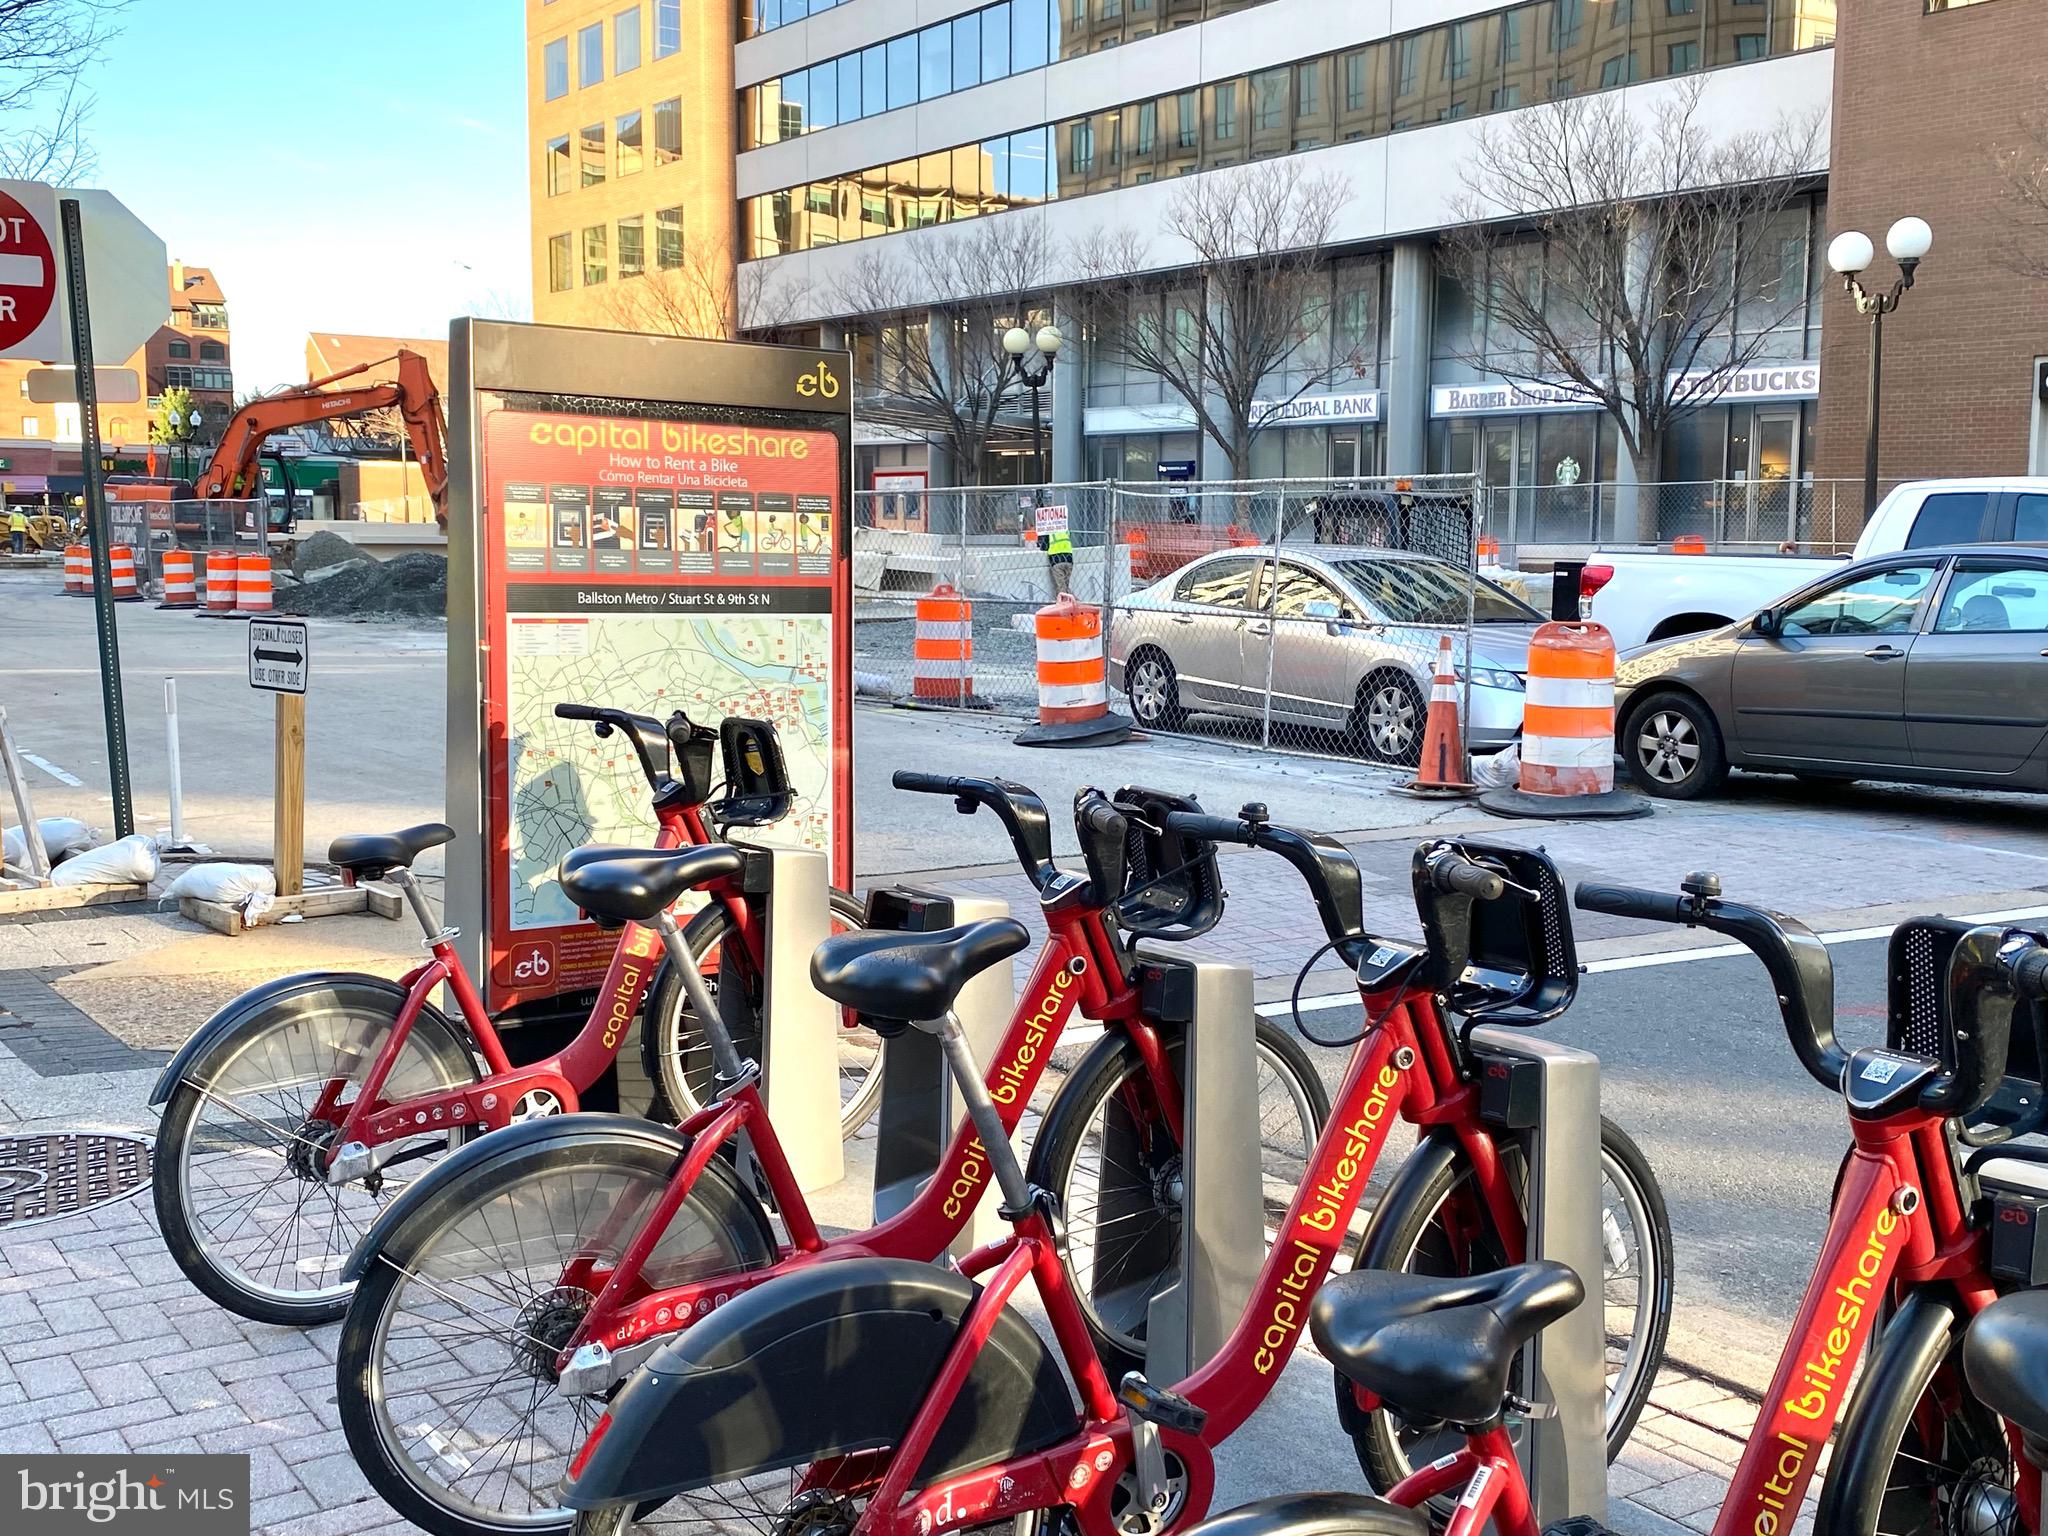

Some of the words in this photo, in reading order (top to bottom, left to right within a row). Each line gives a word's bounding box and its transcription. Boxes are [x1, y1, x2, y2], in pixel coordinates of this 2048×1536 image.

[1674, 370, 1816, 395] STARBUCKS
[321, 398, 351, 409] HITACHI
[1251, 400, 1331, 420] RESIDENTIAL
[1333, 397, 1373, 415] BANK
[1448, 390, 1507, 409] BARBER
[1510, 386, 1550, 406] SHOP
[529, 420, 649, 455] capital
[661, 422, 809, 459] bikeshare
[610, 453, 642, 468] How
[646, 456, 660, 469] to
[664, 456, 695, 471] Rent
[699, 460, 706, 471] a
[711, 458, 738, 473] Bike
[599, 469, 634, 483] Cómo
[637, 472, 674, 484] Rentar
[678, 474, 700, 486] Una
[703, 473, 748, 488] Bicicleta
[1036, 506, 1067, 521] NATIONAL
[577, 591, 622, 605] Ballston
[624, 592, 659, 605] Metro
[660, 592, 667, 605] /
[668, 593, 701, 605] Stuart
[703, 594, 715, 605] St
[716, 594, 725, 605] &
[728, 593, 746, 605] 9th
[748, 594, 759, 605] St
[761, 594, 770, 605] N
[252, 627, 280, 643] SIDEWALK
[281, 630, 303, 644] CLOSED
[254, 668, 266, 682] USE
[268, 669, 285, 684] OTHER
[287, 671, 301, 686] SIDE
[602, 963, 641, 1049] capital
[942, 1136, 987, 1220] capit
[989, 969, 1073, 1105] bikeshare
[1253, 1239, 1321, 1375] capital
[1298, 1065, 1399, 1232] bikeshare
[1783, 1206, 1898, 1420] bikeshare
